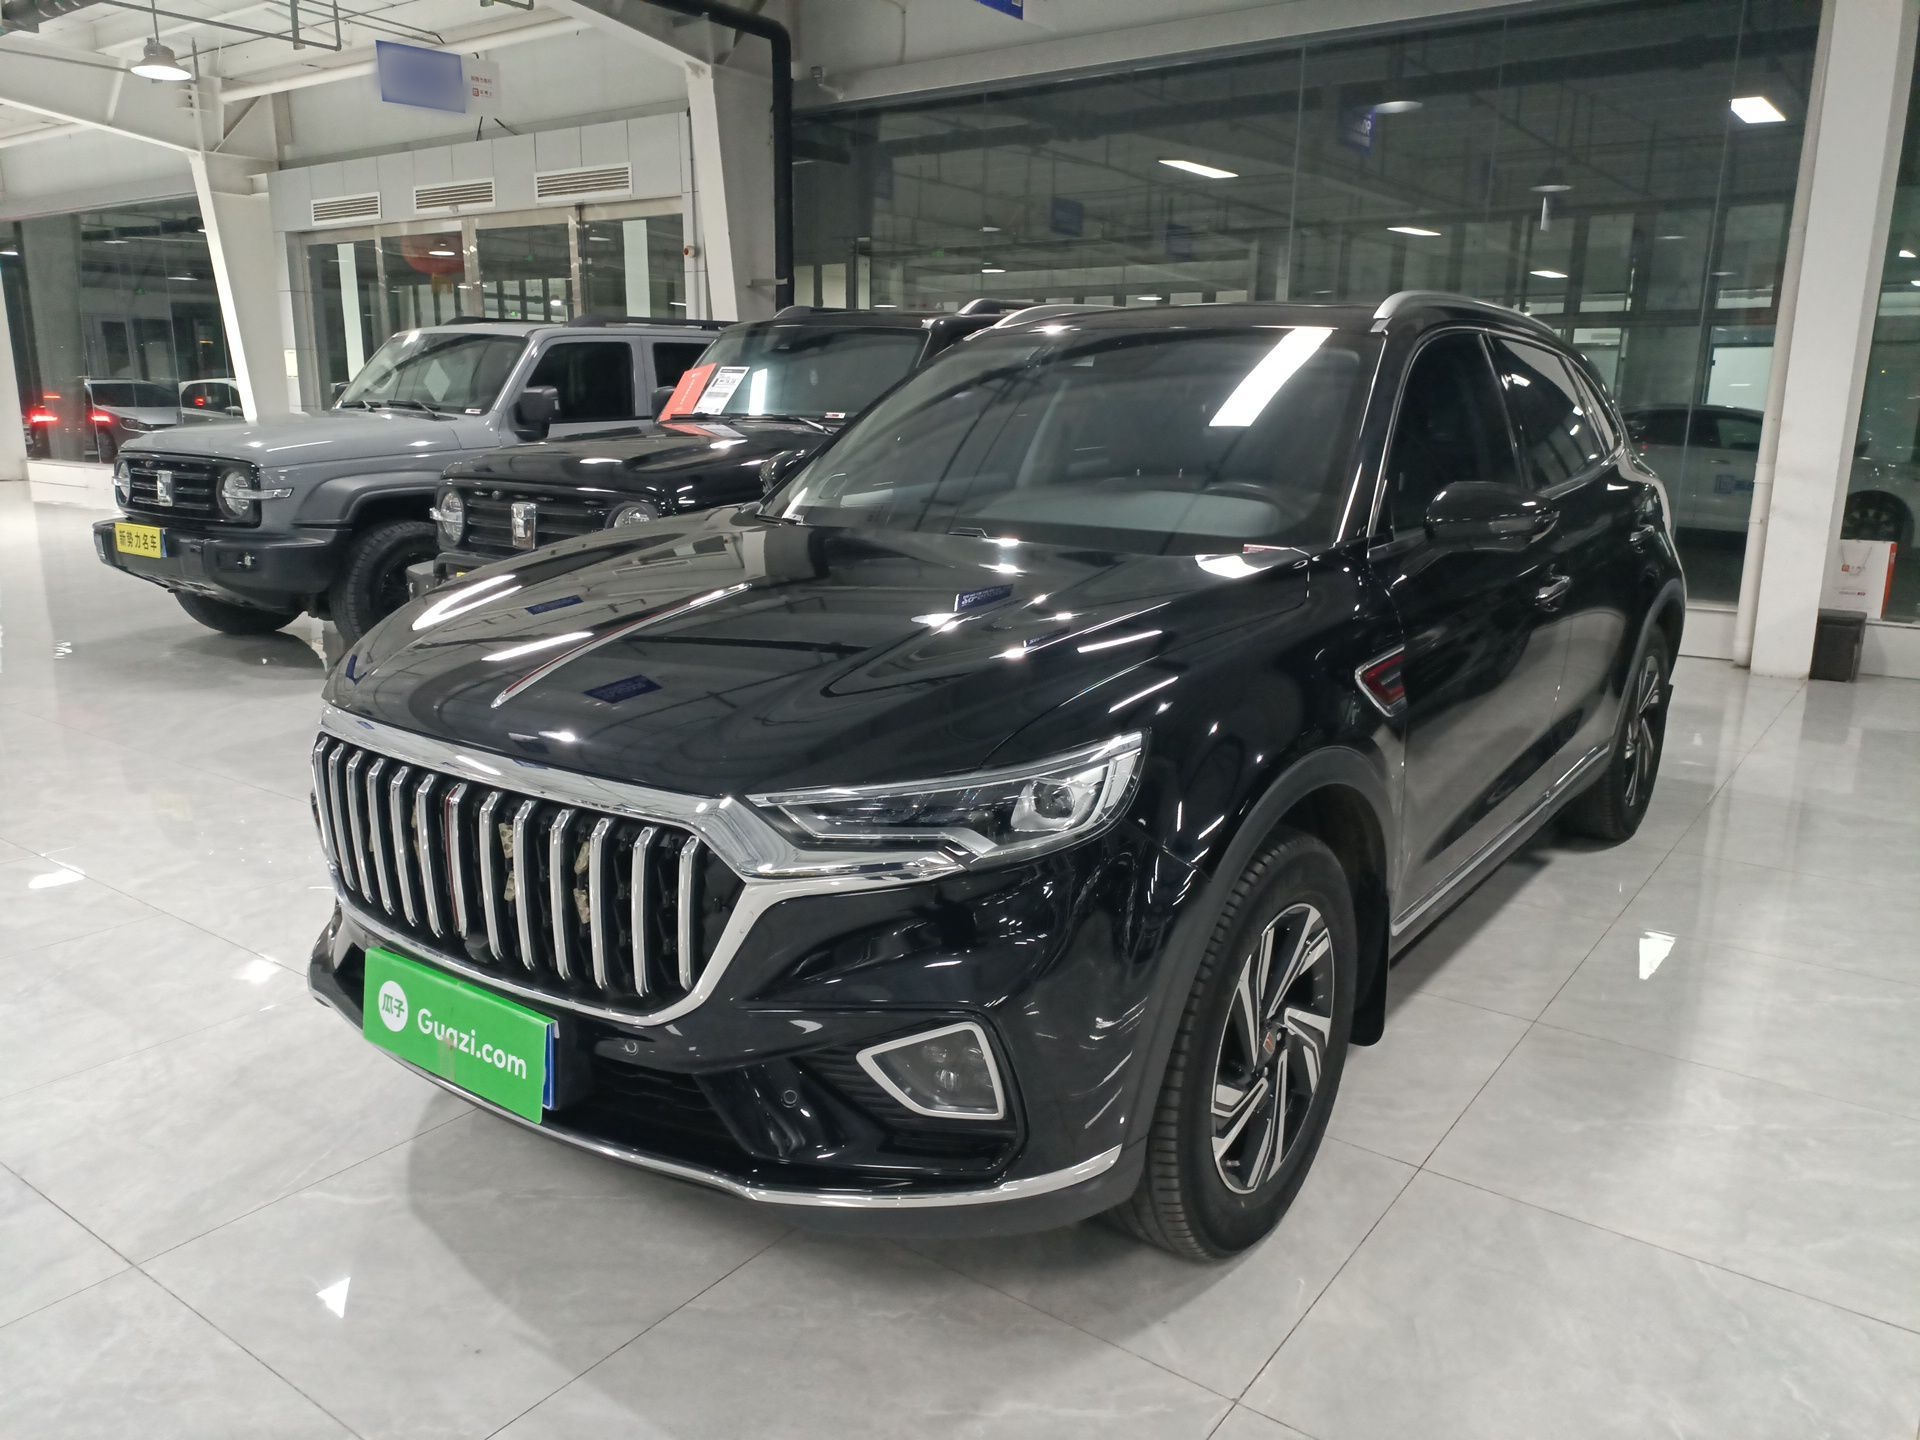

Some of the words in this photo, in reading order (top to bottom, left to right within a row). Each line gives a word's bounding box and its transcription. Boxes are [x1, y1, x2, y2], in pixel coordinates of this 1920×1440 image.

[119, 530, 157, 551] 新势力名车
[382, 993, 405, 1018] 瓜子
[417, 1008, 527, 1080] Guazi.com
